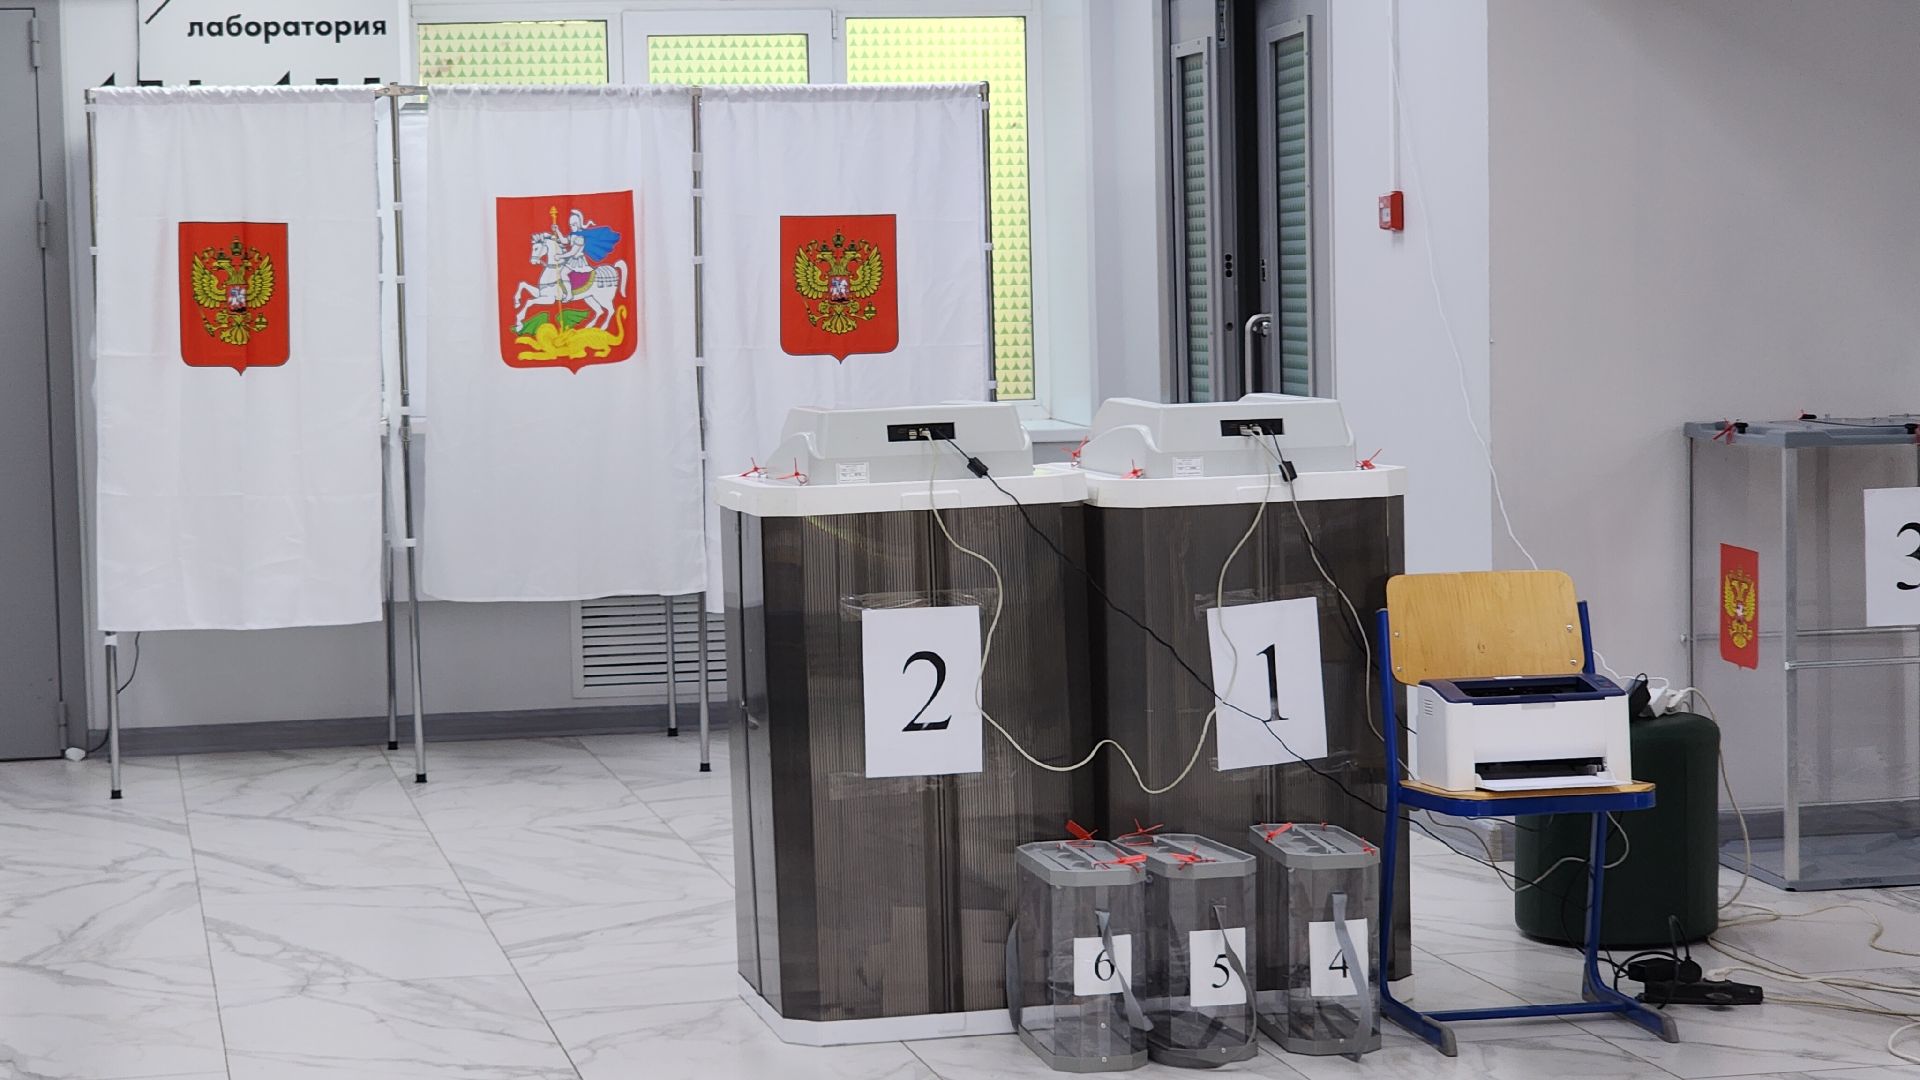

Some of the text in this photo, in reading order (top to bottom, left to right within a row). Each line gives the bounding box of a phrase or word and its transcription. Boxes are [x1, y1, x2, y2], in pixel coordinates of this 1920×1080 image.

[187, 13, 387, 44] лаборатория
[1896, 522, 1920, 591] 3
[902, 650, 952, 732] 2
[1256, 643, 1289, 722] 1
[1094, 949, 1116, 982] 6
[1211, 953, 1230, 989] 5
[1328, 948, 1350, 979] 4
